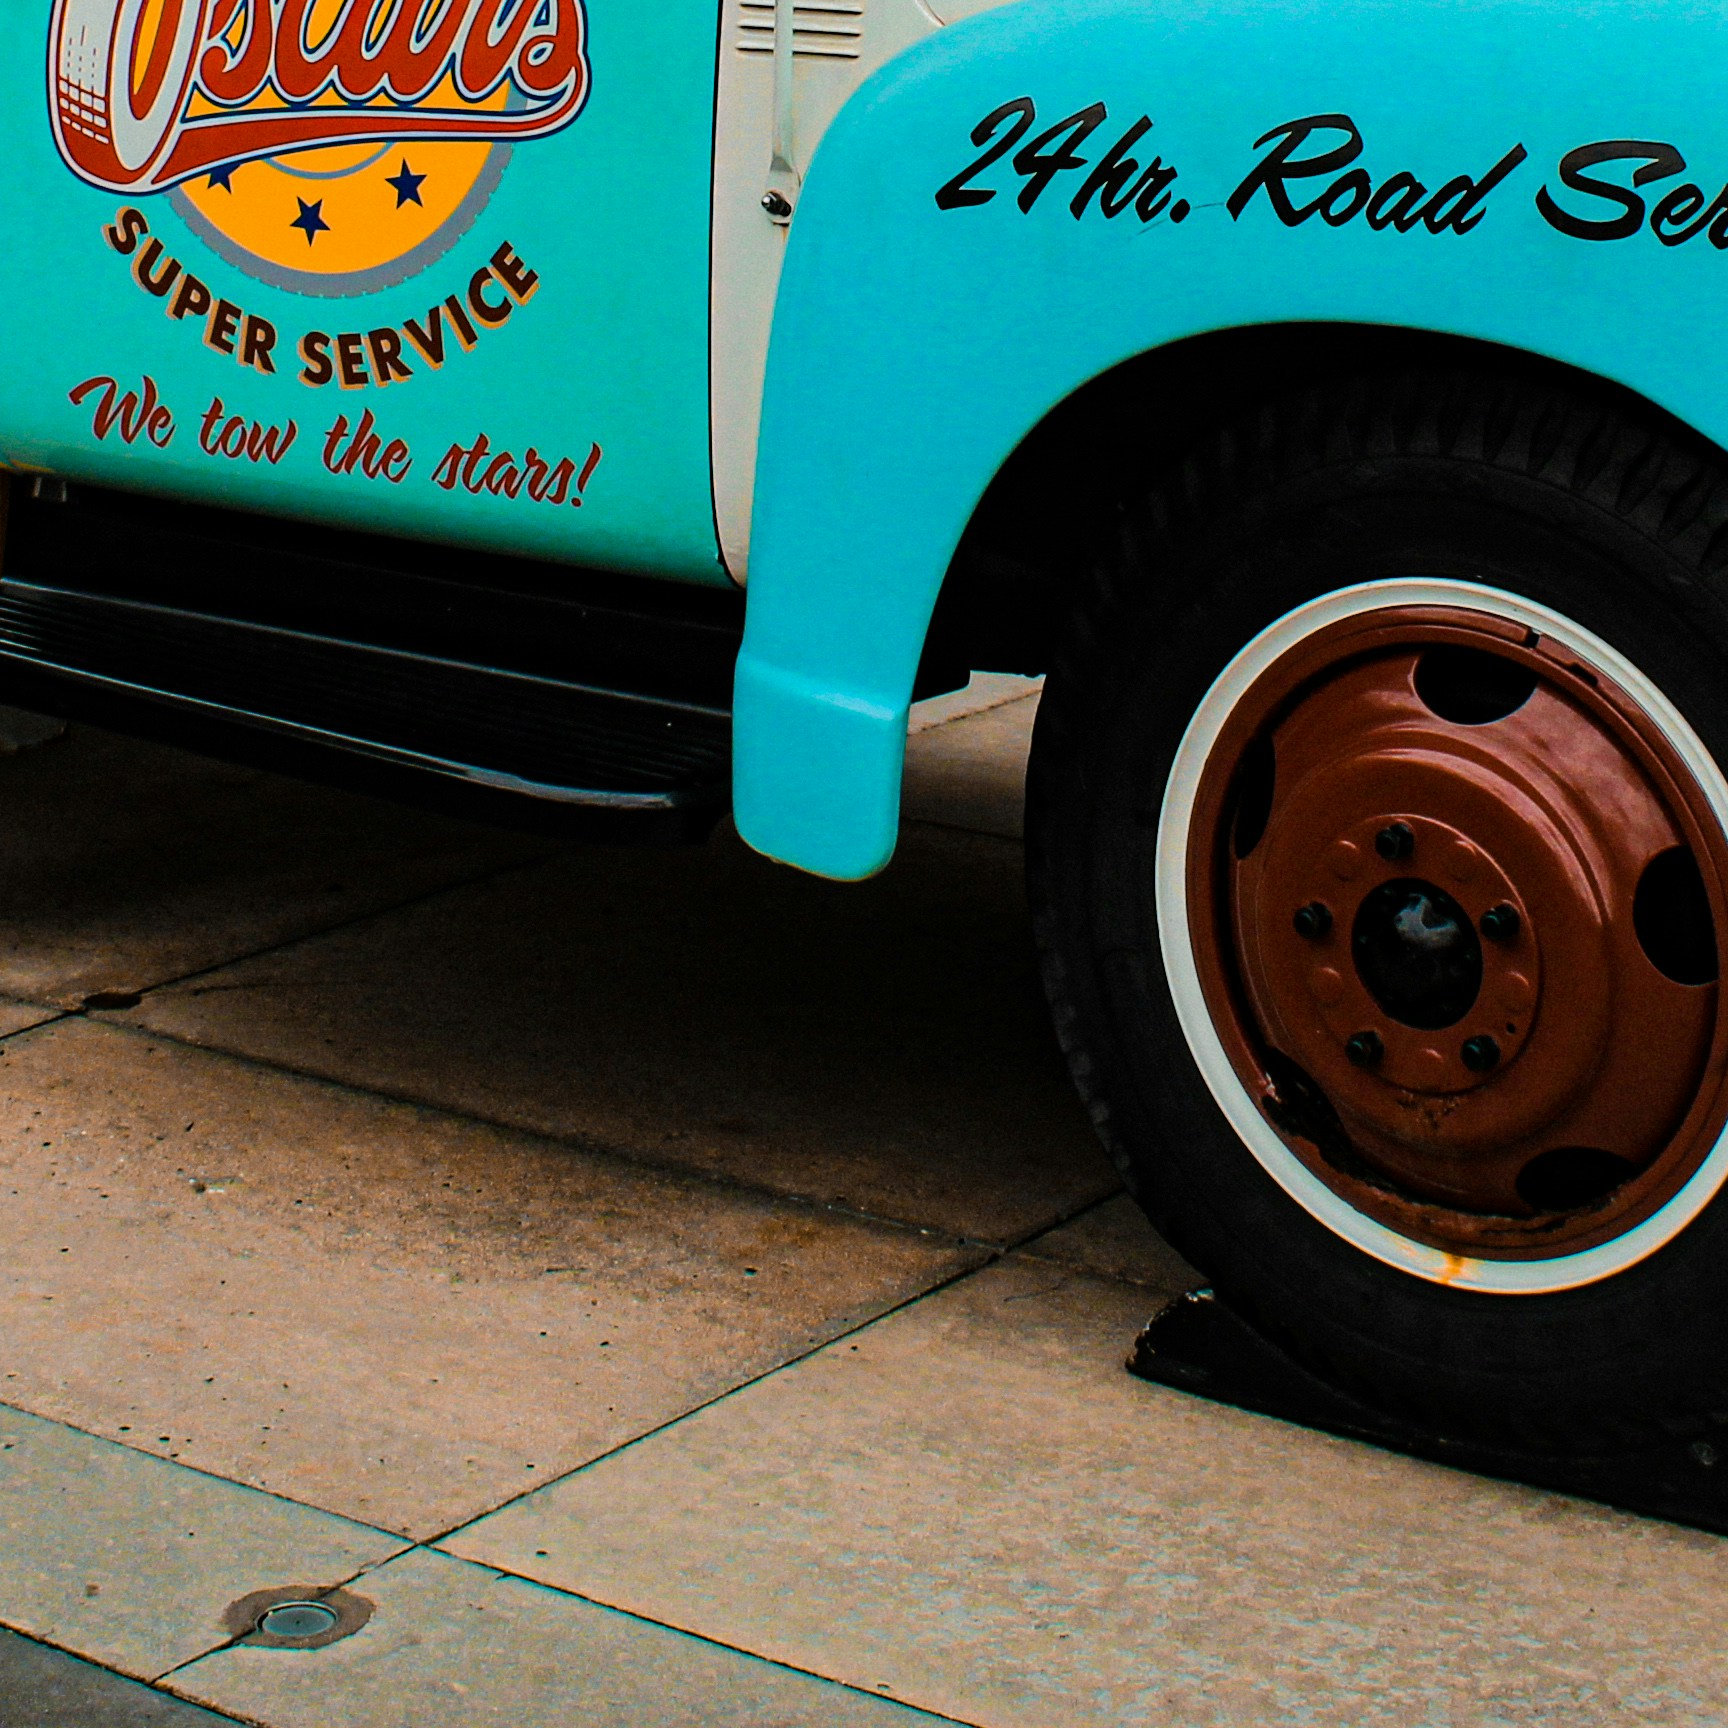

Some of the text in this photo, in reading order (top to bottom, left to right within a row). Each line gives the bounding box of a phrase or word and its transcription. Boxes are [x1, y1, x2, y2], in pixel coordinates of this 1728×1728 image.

[1227, 113, 1528, 235] Road
[101, 206, 540, 391] SUPER SERVICE
[68, 374, 603, 509] We tow the stars!
